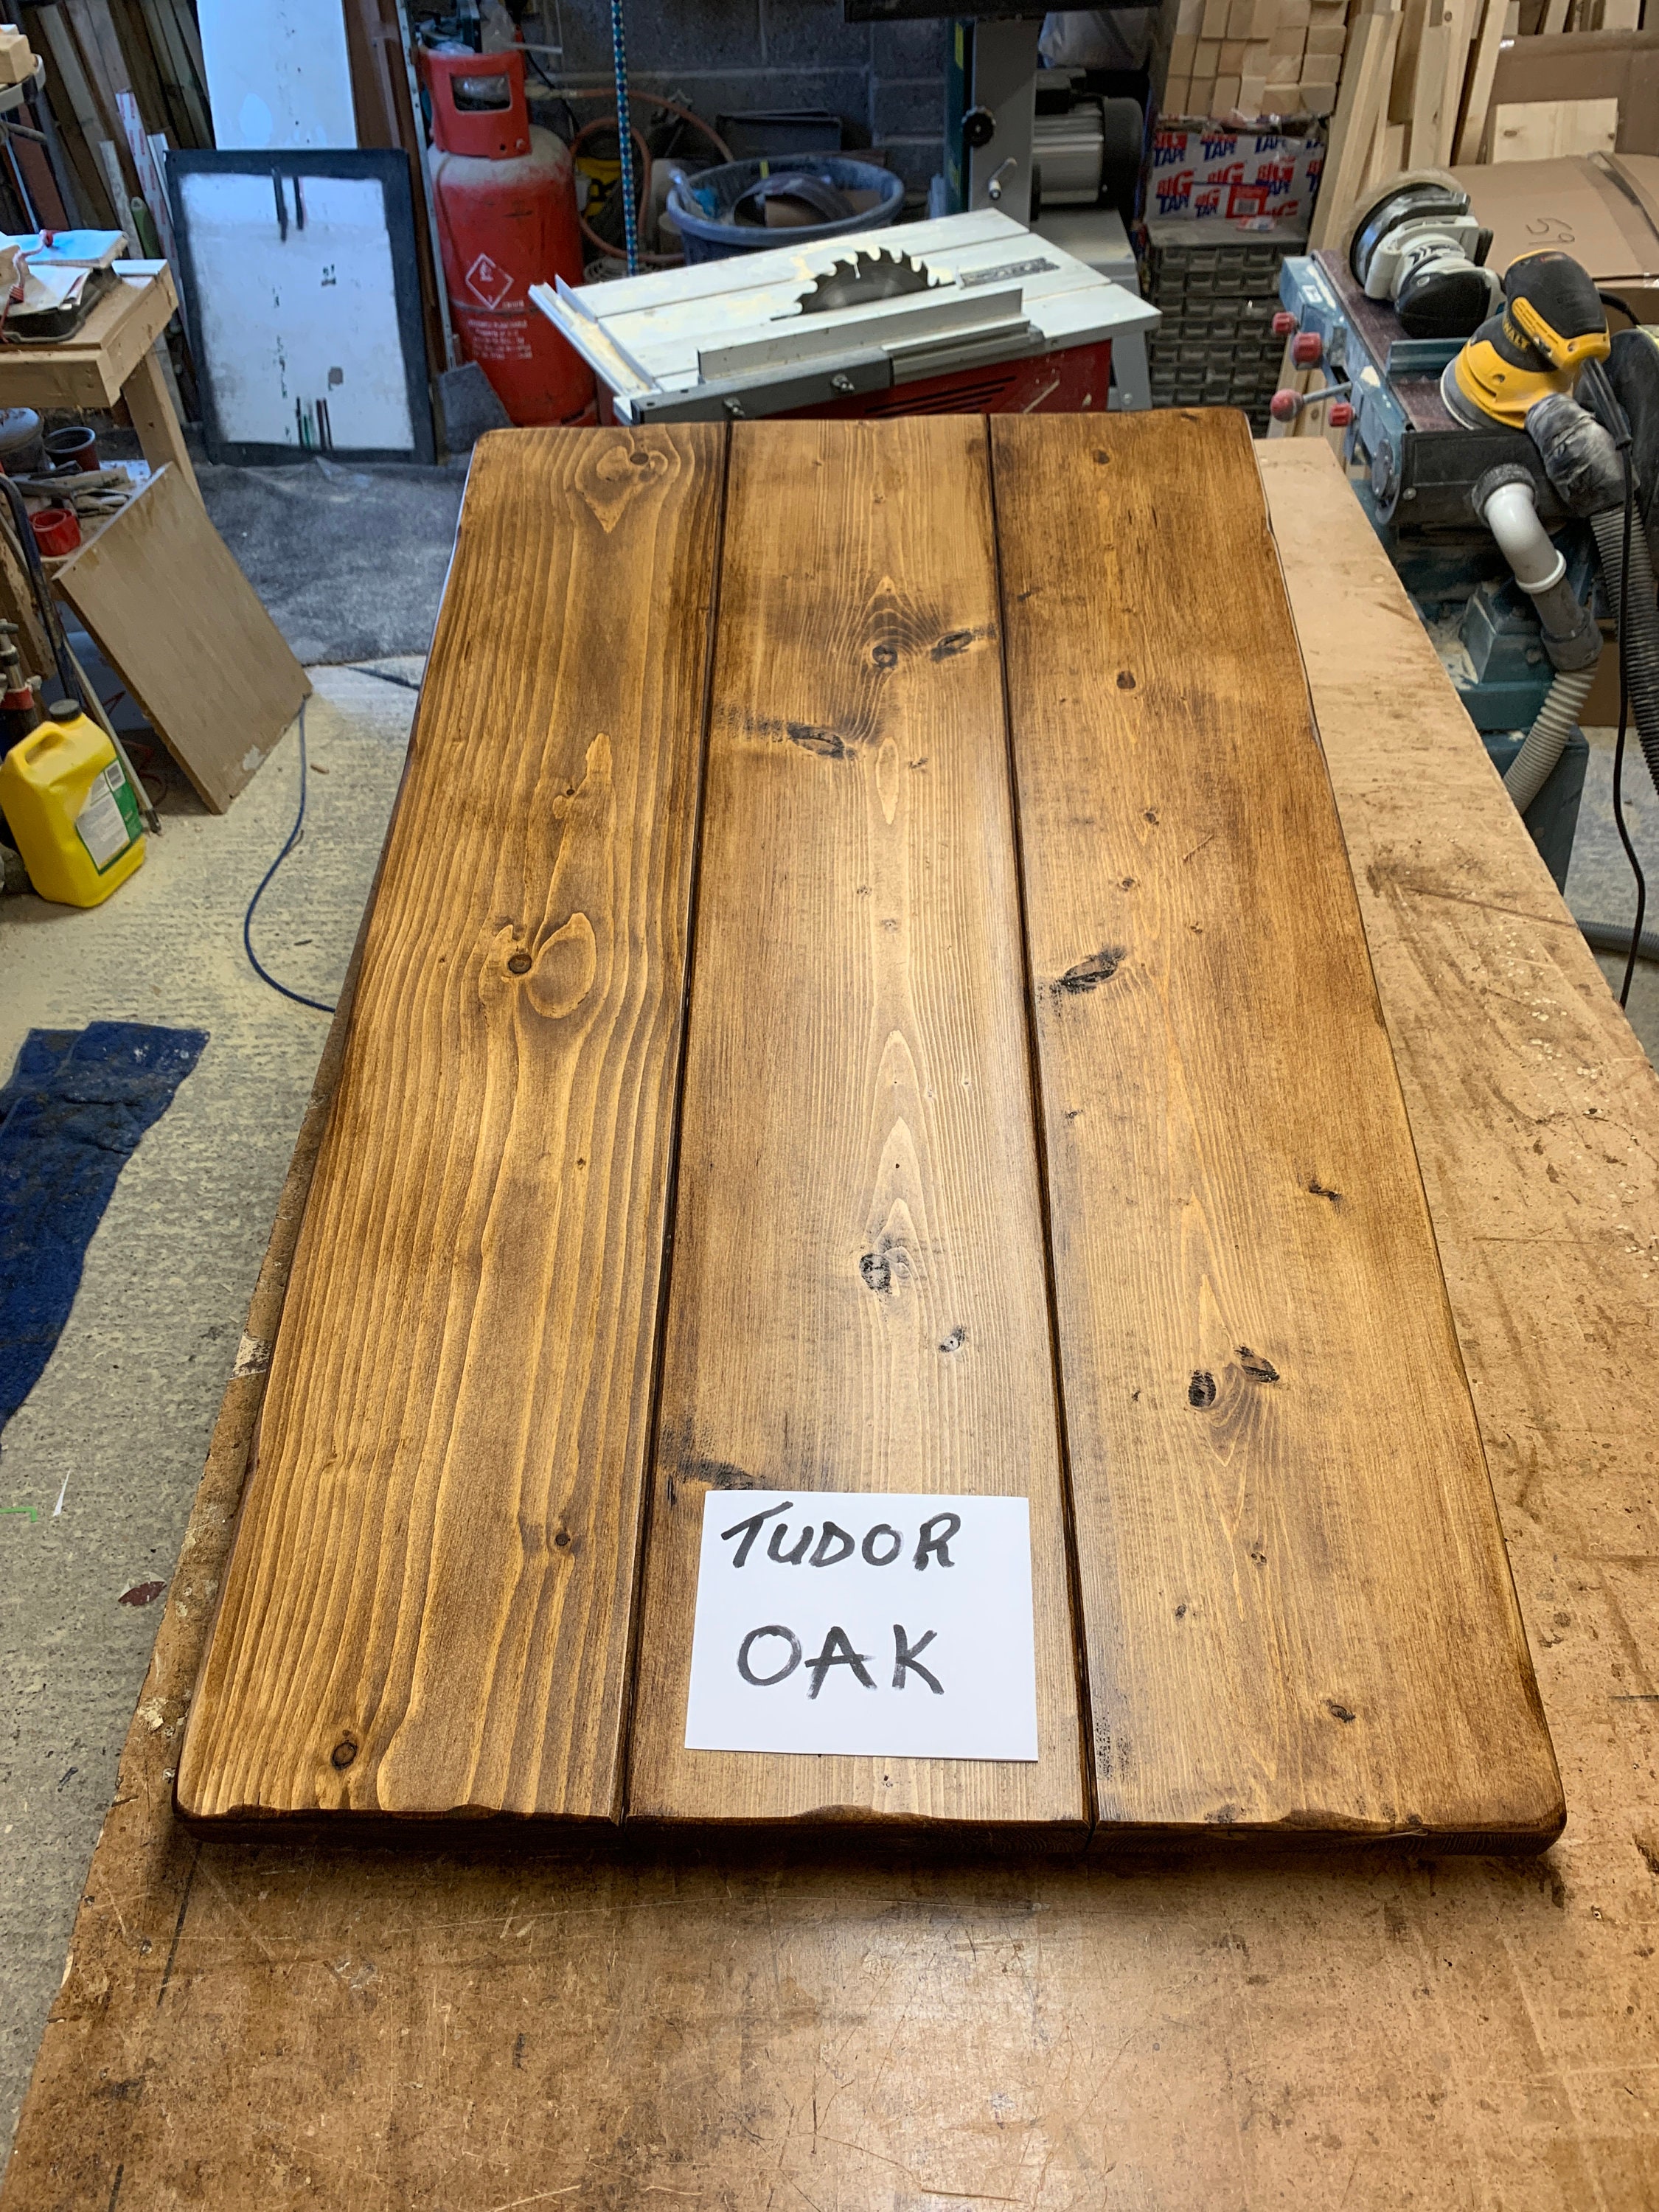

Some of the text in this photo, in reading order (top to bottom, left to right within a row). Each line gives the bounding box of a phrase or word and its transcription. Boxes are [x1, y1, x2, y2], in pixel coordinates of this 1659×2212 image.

[1156, 170, 1194, 197] BIG
[720, 1500, 961, 1571] TUDOR
[737, 1624, 945, 1700] OAK
